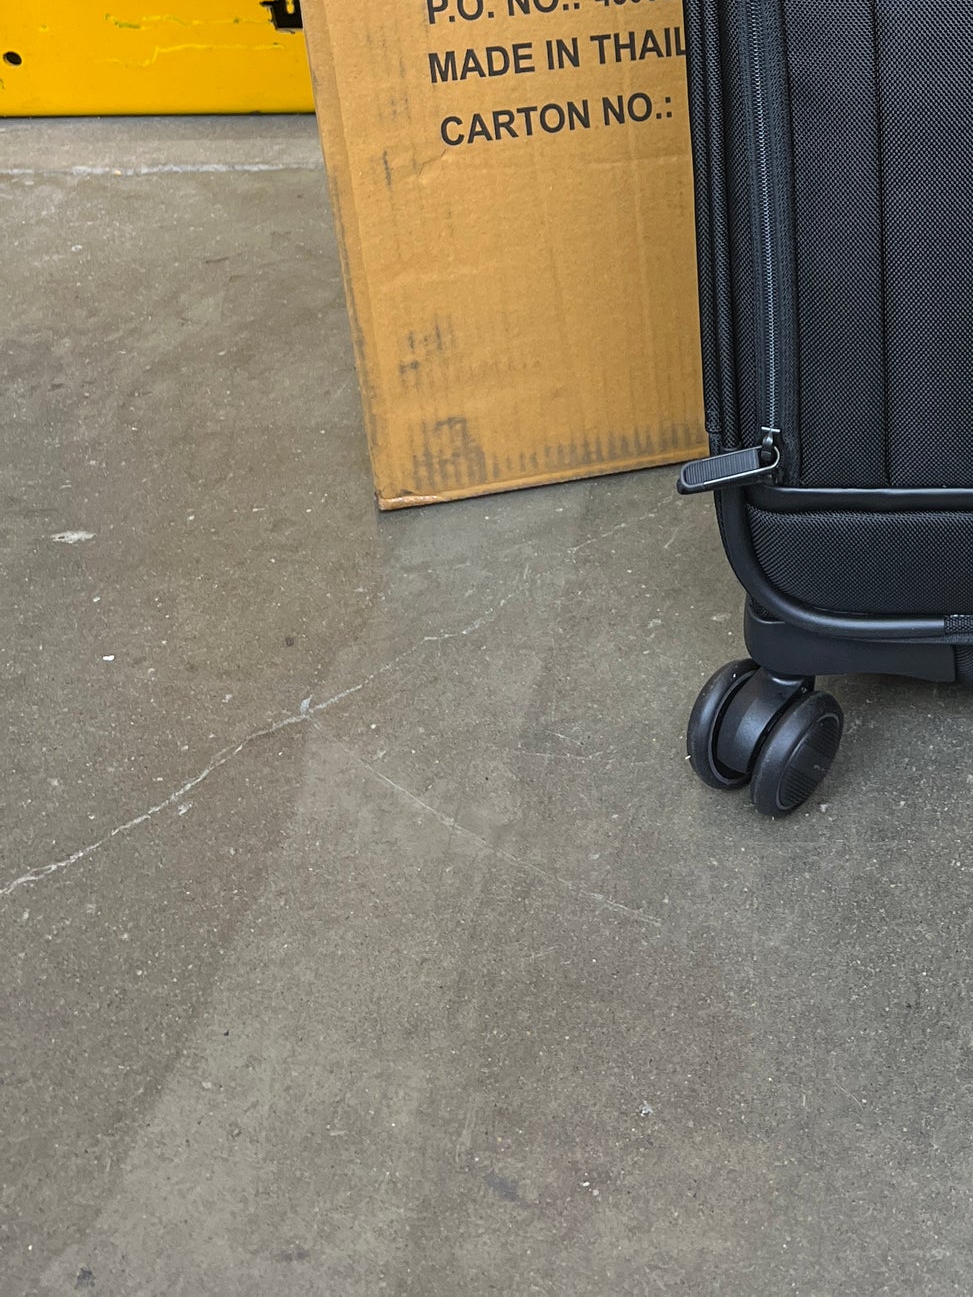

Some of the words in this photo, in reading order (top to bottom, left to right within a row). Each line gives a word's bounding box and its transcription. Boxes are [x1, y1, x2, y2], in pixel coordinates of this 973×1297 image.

[428, 42, 536, 83] MADE
[546, 37, 581, 71] IN
[590, 27, 687, 65] THAIL
[440, 99, 591, 146] CARTON
[603, 92, 673, 126] NO.:
